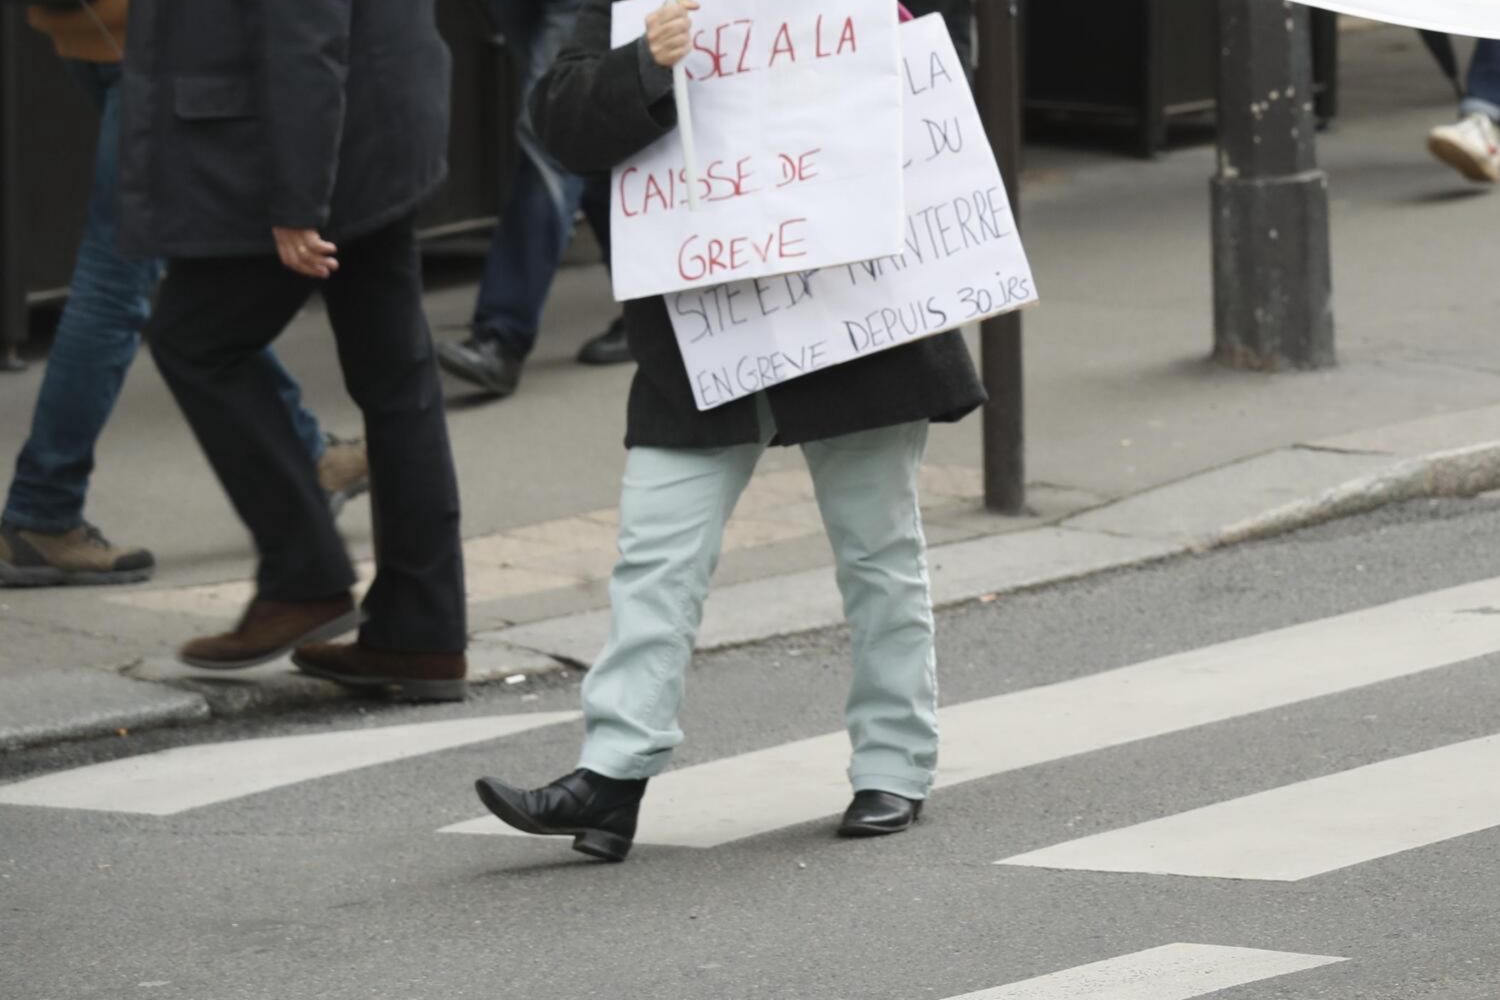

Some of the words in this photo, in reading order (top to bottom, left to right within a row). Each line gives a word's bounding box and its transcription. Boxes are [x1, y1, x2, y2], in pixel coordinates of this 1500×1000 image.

[685, 19, 760, 82] SEZ
[769, 22, 797, 68] A
[815, 13, 857, 60] LA
[903, 50, 953, 96] LA
[922, 116, 964, 161] DU
[619, 155, 762, 218] CAISSE
[776, 148, 823, 189] DE
[677, 218, 808, 282] GREVE
[674, 282, 747, 344] SITE
[697, 366, 735, 407] EN
[735, 340, 831, 393] GREVE
[843, 296, 948, 352] DEPUIS
